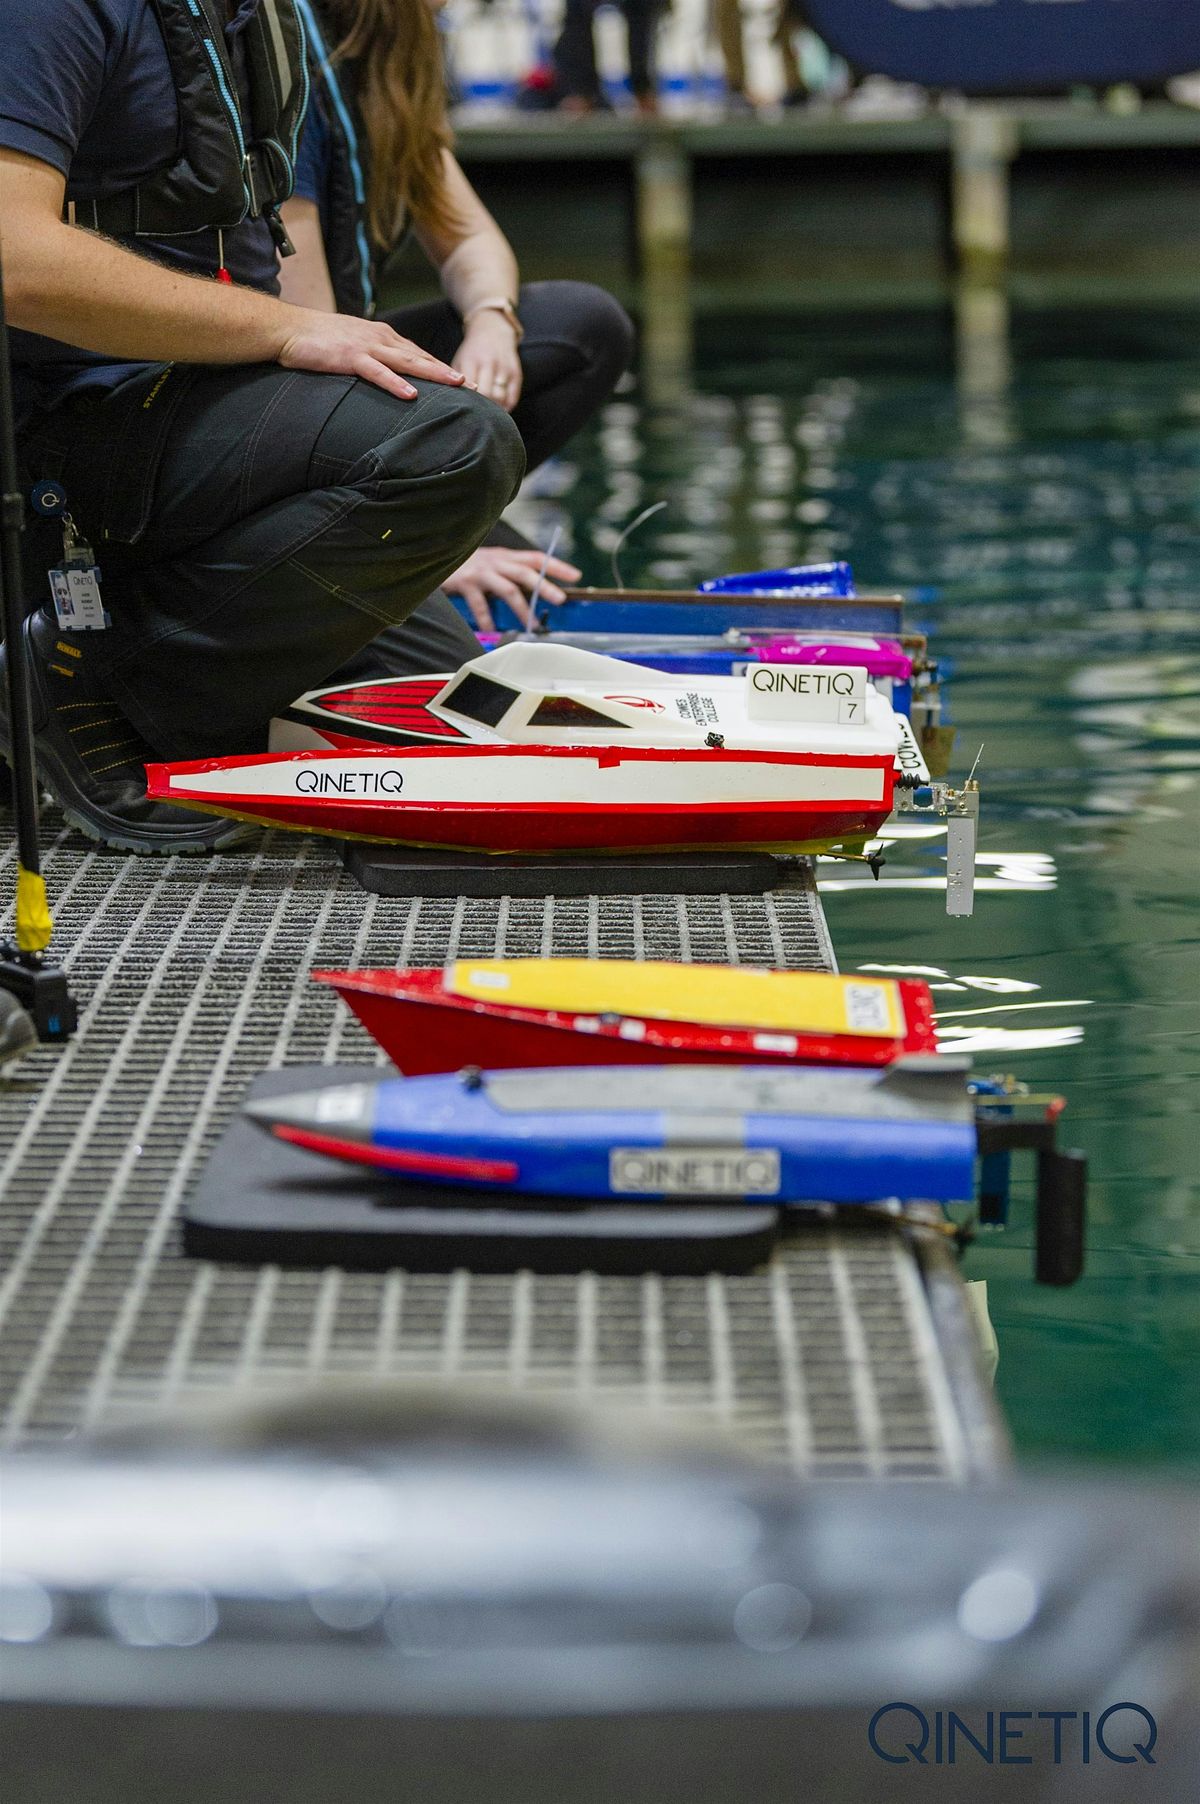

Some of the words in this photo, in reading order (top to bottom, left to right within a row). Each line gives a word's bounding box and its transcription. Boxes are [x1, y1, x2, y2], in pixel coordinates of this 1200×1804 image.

[753, 669, 854, 696] QINETIQ
[675, 699, 692, 719] COWES
[700, 697, 720, 723] COLLEGE
[847, 703, 858, 719] 7
[295, 770, 404, 793] QINETIQ
